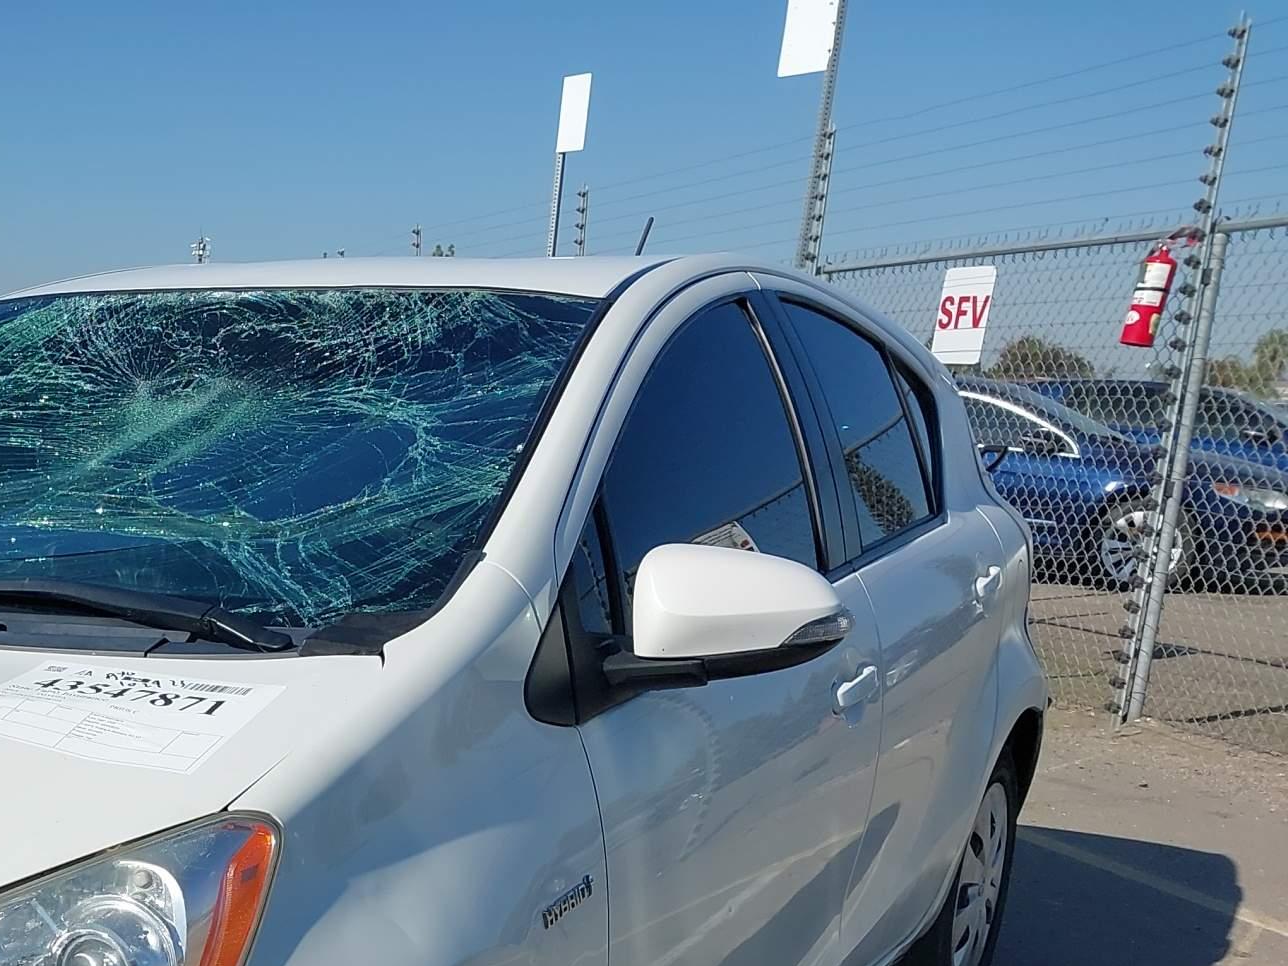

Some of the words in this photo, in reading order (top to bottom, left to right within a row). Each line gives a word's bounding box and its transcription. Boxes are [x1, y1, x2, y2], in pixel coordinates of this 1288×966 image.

[937, 295, 991, 330] SFV
[34, 678, 227, 716] 43547871
[542, 882, 593, 930] HYBRID
